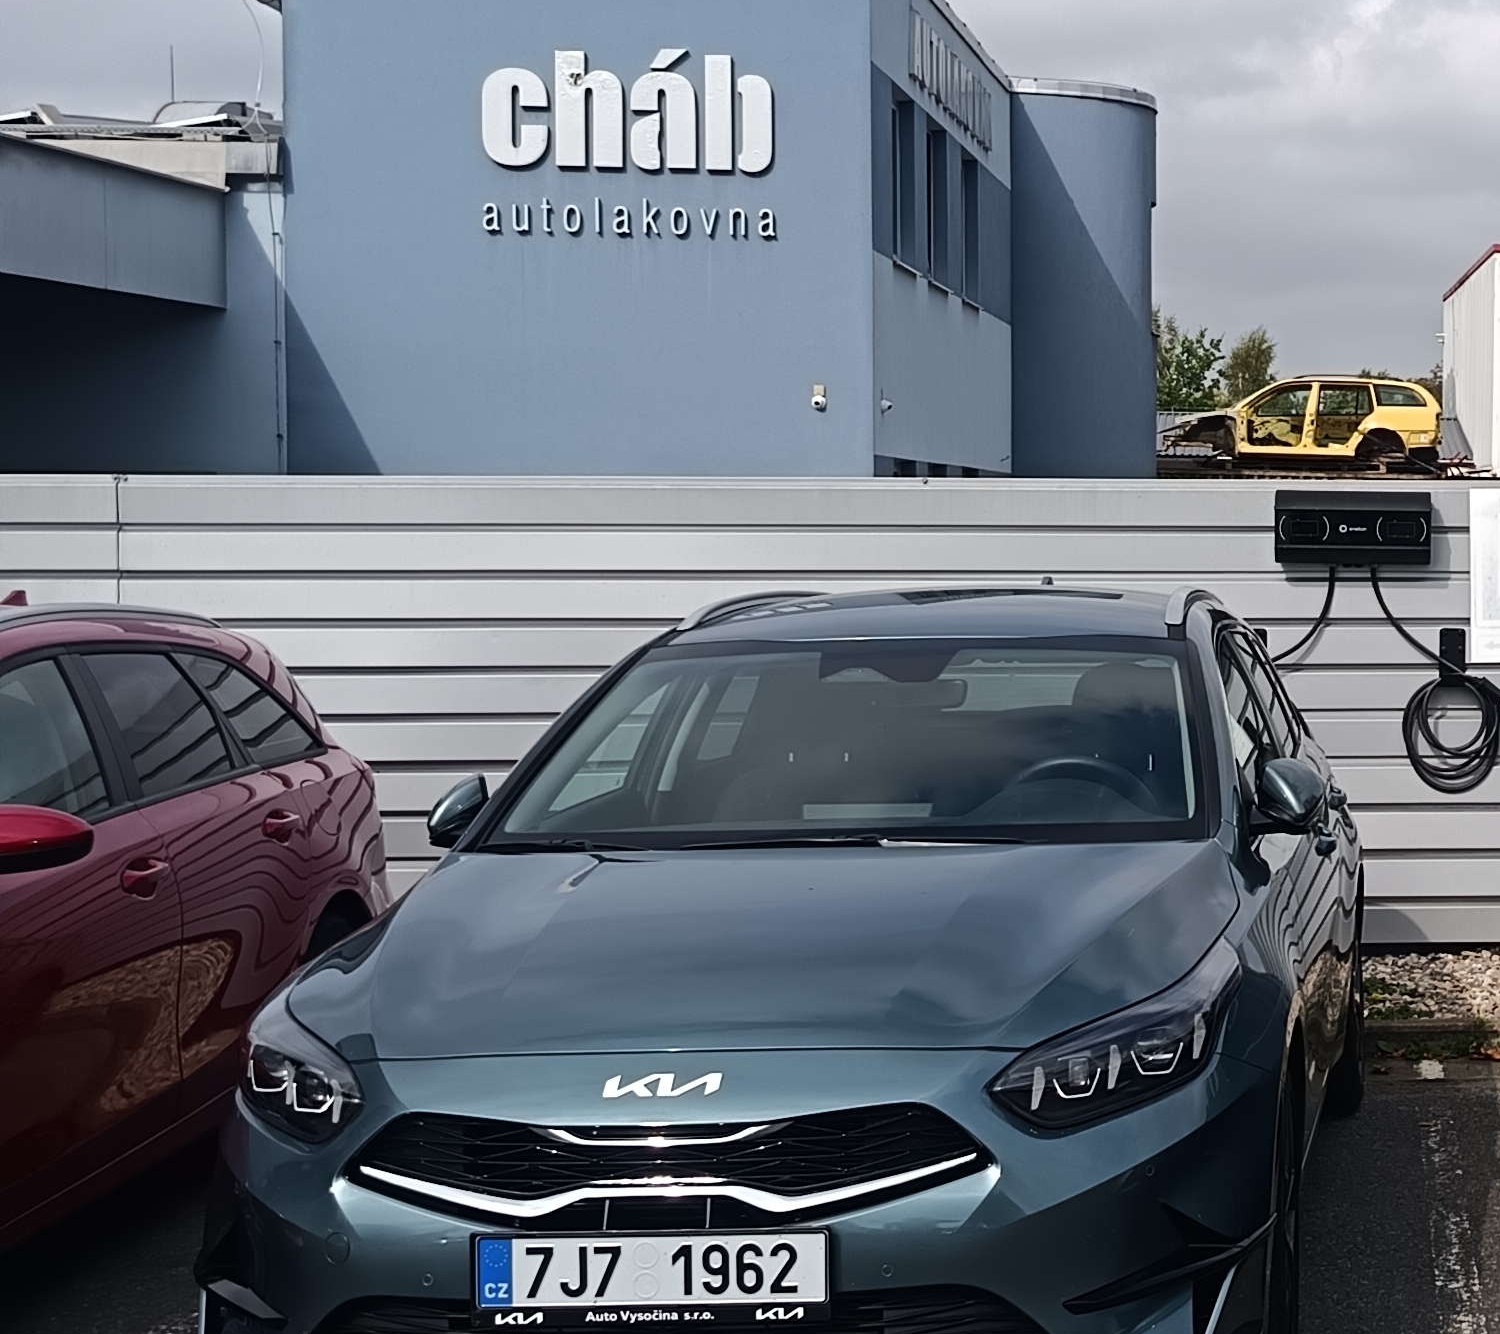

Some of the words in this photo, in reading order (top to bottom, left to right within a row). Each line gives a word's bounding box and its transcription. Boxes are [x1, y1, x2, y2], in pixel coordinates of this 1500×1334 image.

[481, 48, 774, 173] cháb
[481, 197, 778, 239] autolakovna
[525, 1243, 622, 1299] 7J7
[671, 1240, 799, 1296] 1962
[484, 1283, 509, 1299] CZ
[585, 1311, 618, 1323] Auto
[620, 1310, 679, 1324] Vysočina
[683, 1311, 715, 1321] s.r.o.
